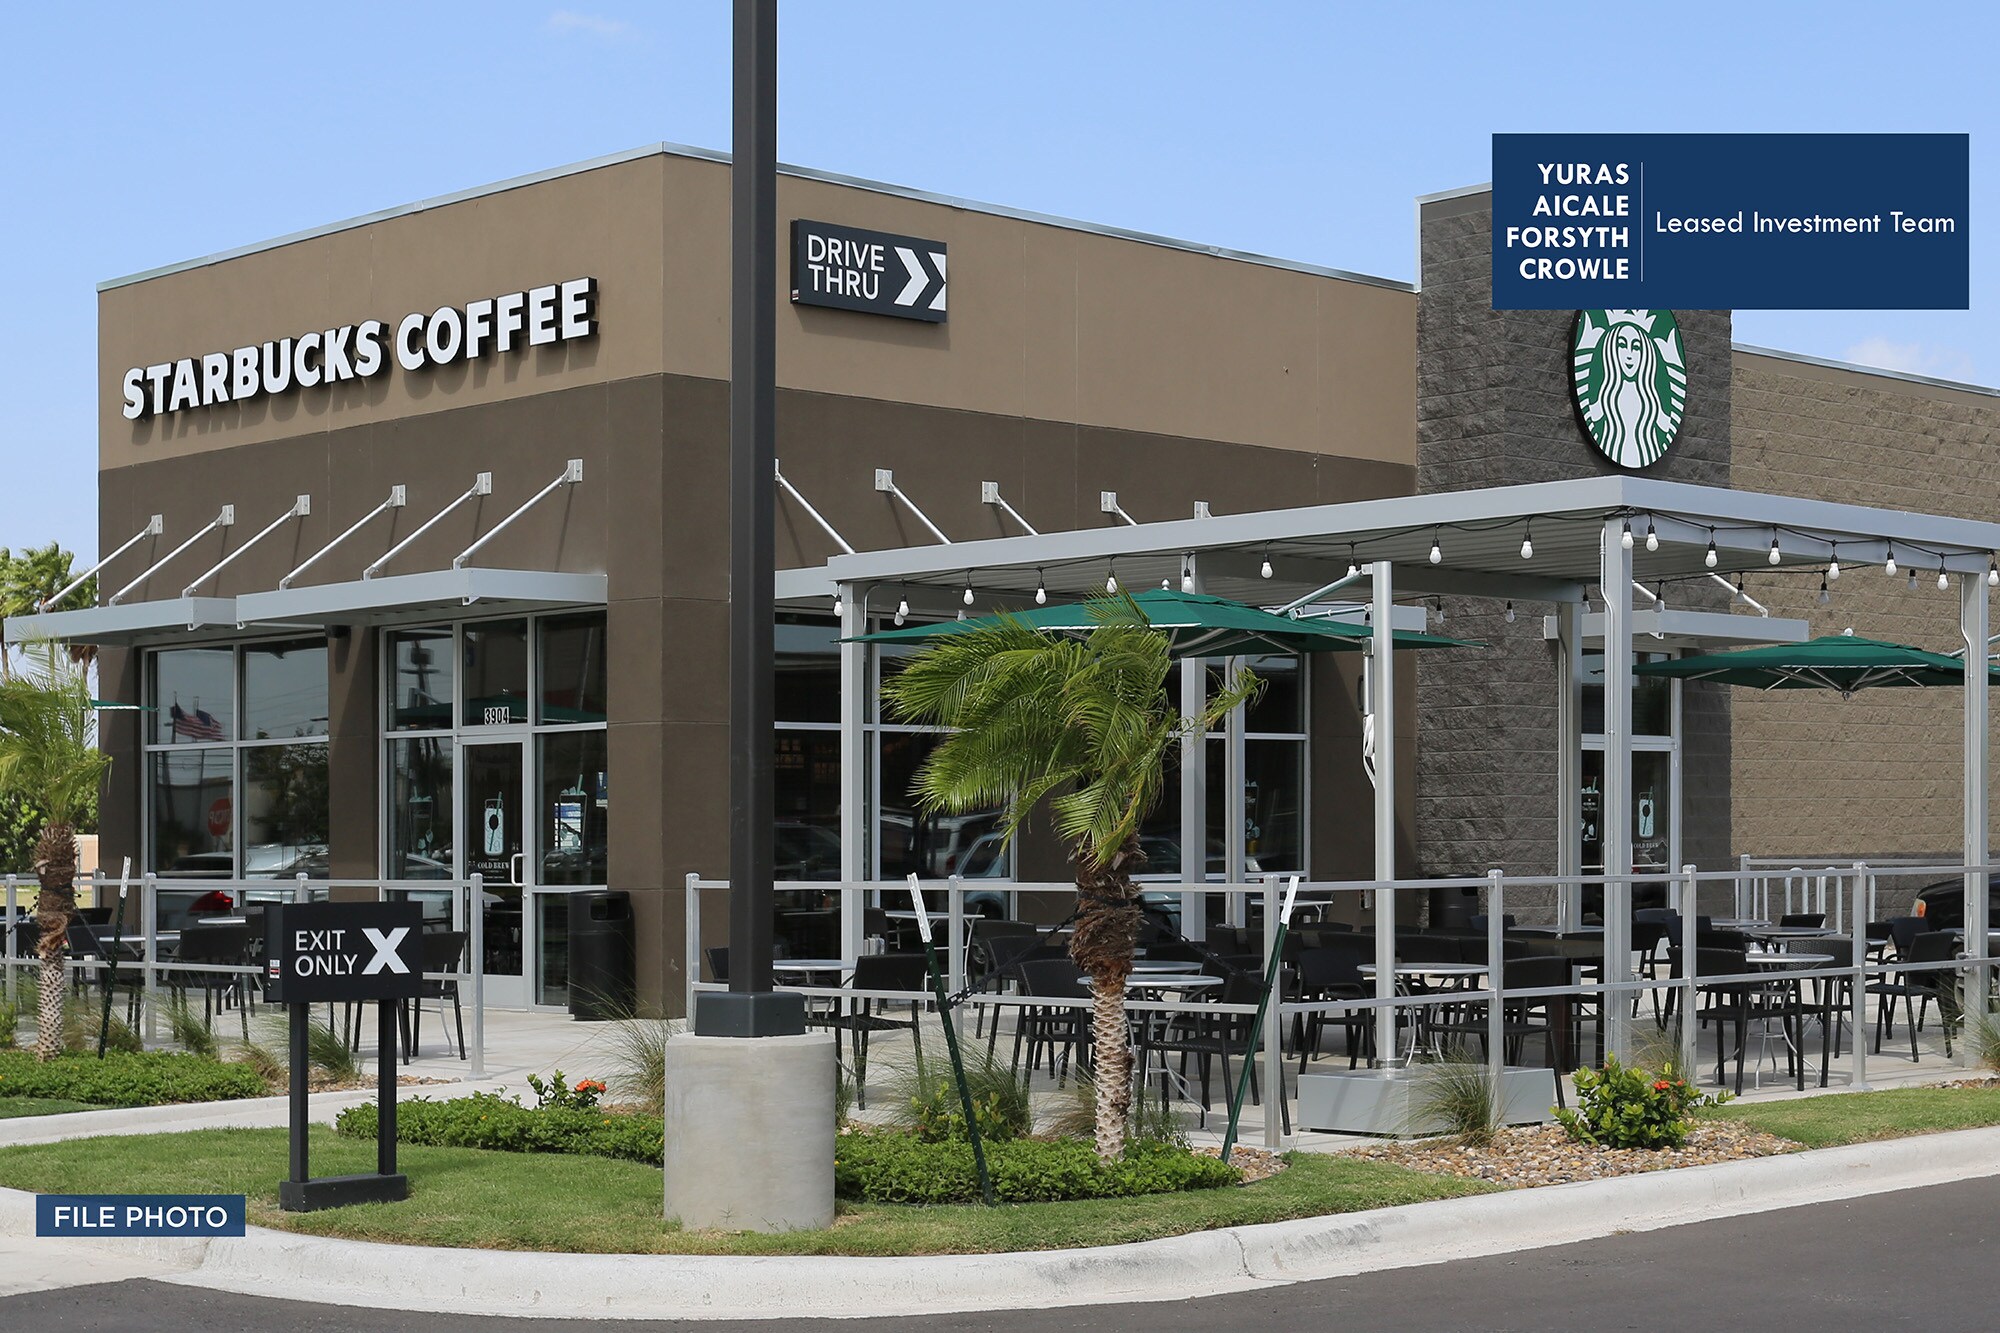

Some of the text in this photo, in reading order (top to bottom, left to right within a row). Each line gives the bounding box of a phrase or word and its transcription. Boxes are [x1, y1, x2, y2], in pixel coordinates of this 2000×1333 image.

[807, 234, 885, 272] DRIVE
[807, 263, 879, 300] THRU
[122, 277, 597, 420] STARBUCKS COFFEE
[485, 707, 508, 724] 3904
[477, 861, 510, 869] COLD BREW
[295, 930, 346, 951] EXIT
[295, 953, 358, 977] ONLY
